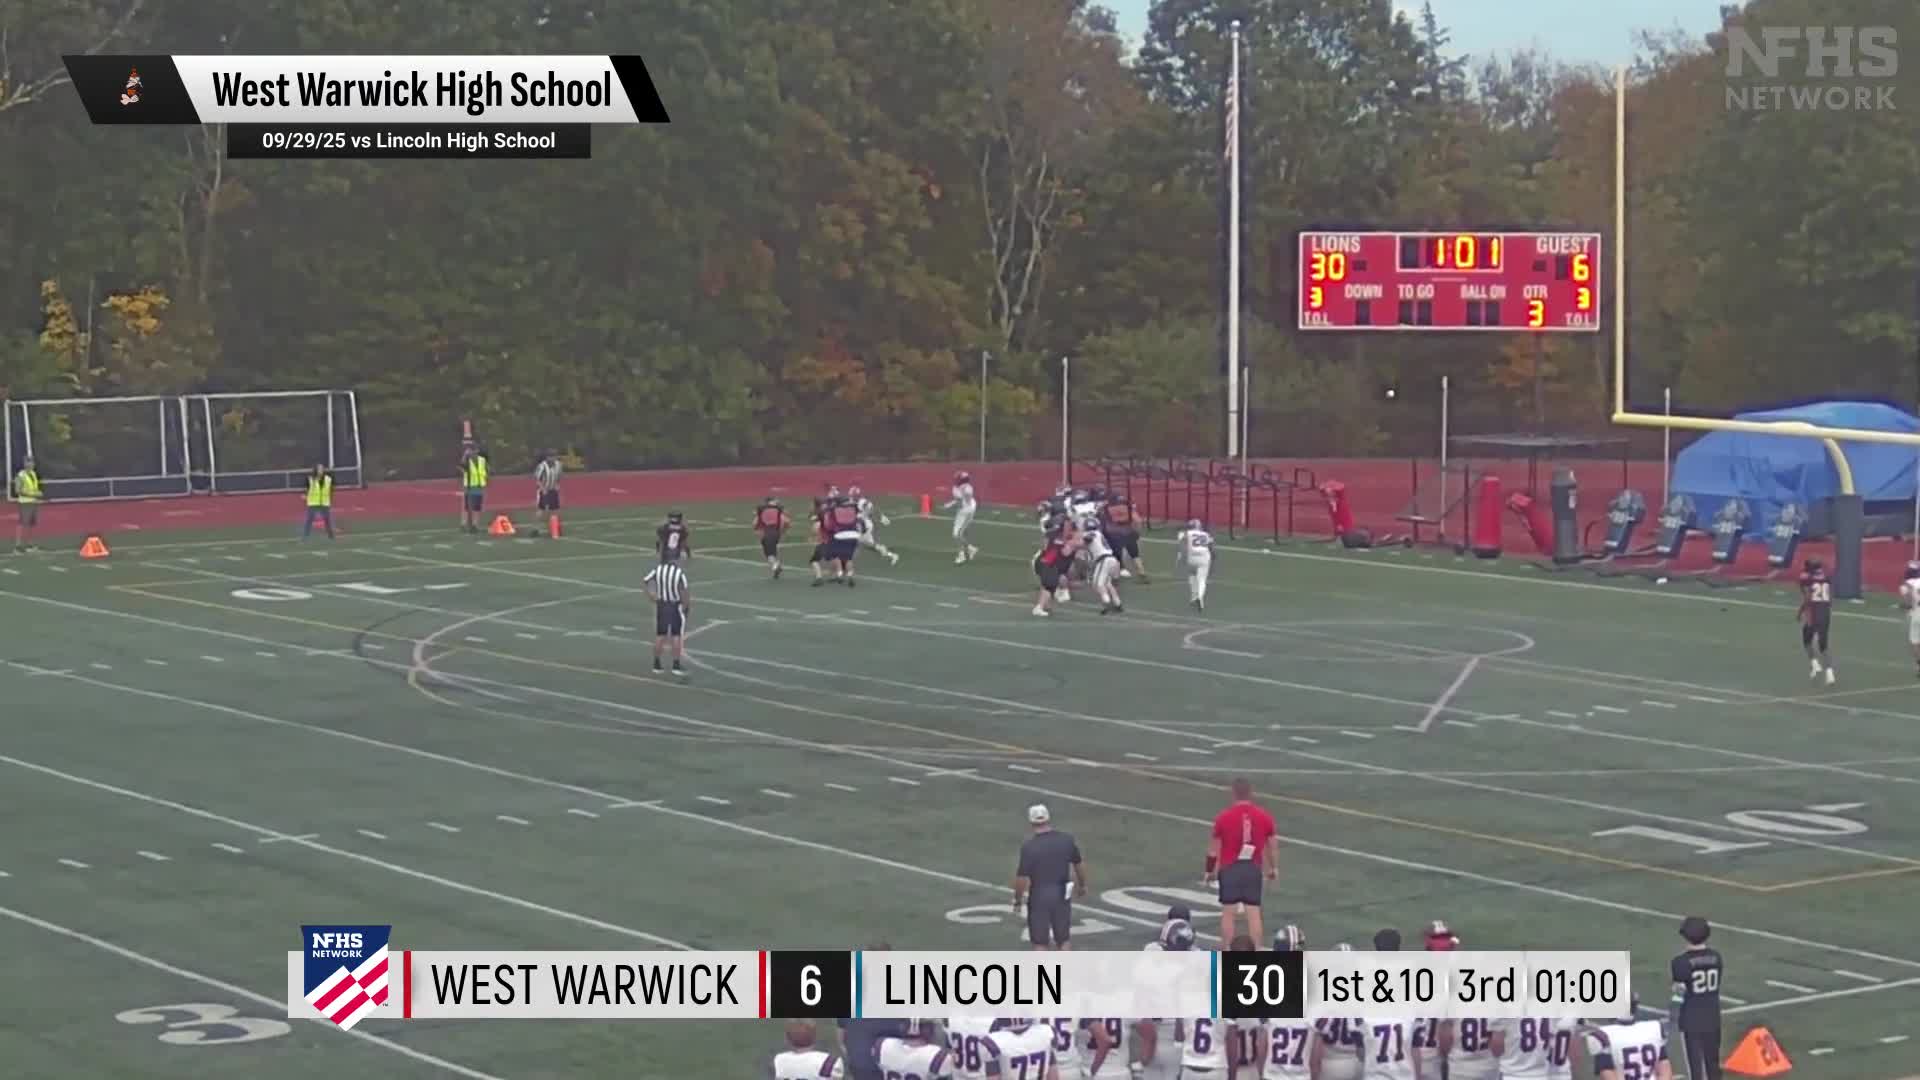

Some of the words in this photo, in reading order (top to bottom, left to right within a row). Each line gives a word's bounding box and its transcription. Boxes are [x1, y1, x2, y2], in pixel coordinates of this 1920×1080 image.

[1311, 236, 1361, 252] LIONS
[1536, 236, 1592, 254] GUEST
[1311, 253, 1345, 280] 30
[1572, 254, 1589, 281] 6
[1310, 287, 1323, 308] 3
[1344, 284, 1383, 299] DOWN
[1397, 284, 1415, 299] TO
[1416, 284, 1435, 299] GO
[1460, 284, 1487, 299] BALL
[1489, 284, 1506, 299] ON
[1577, 287, 1590, 310] 3
[1529, 300, 1544, 327] 3
[1592, 809, 1869, 854] 10
[1692, 969, 1718, 993] 20
[115, 1003, 291, 1045] 3
[1194, 1018, 1212, 1054] 6
[951, 1032, 981, 1071] 38
[1271, 1028, 1308, 1065] 27
[1373, 1024, 1404, 1063] 71
[1011, 1051, 1047, 1080] 77
